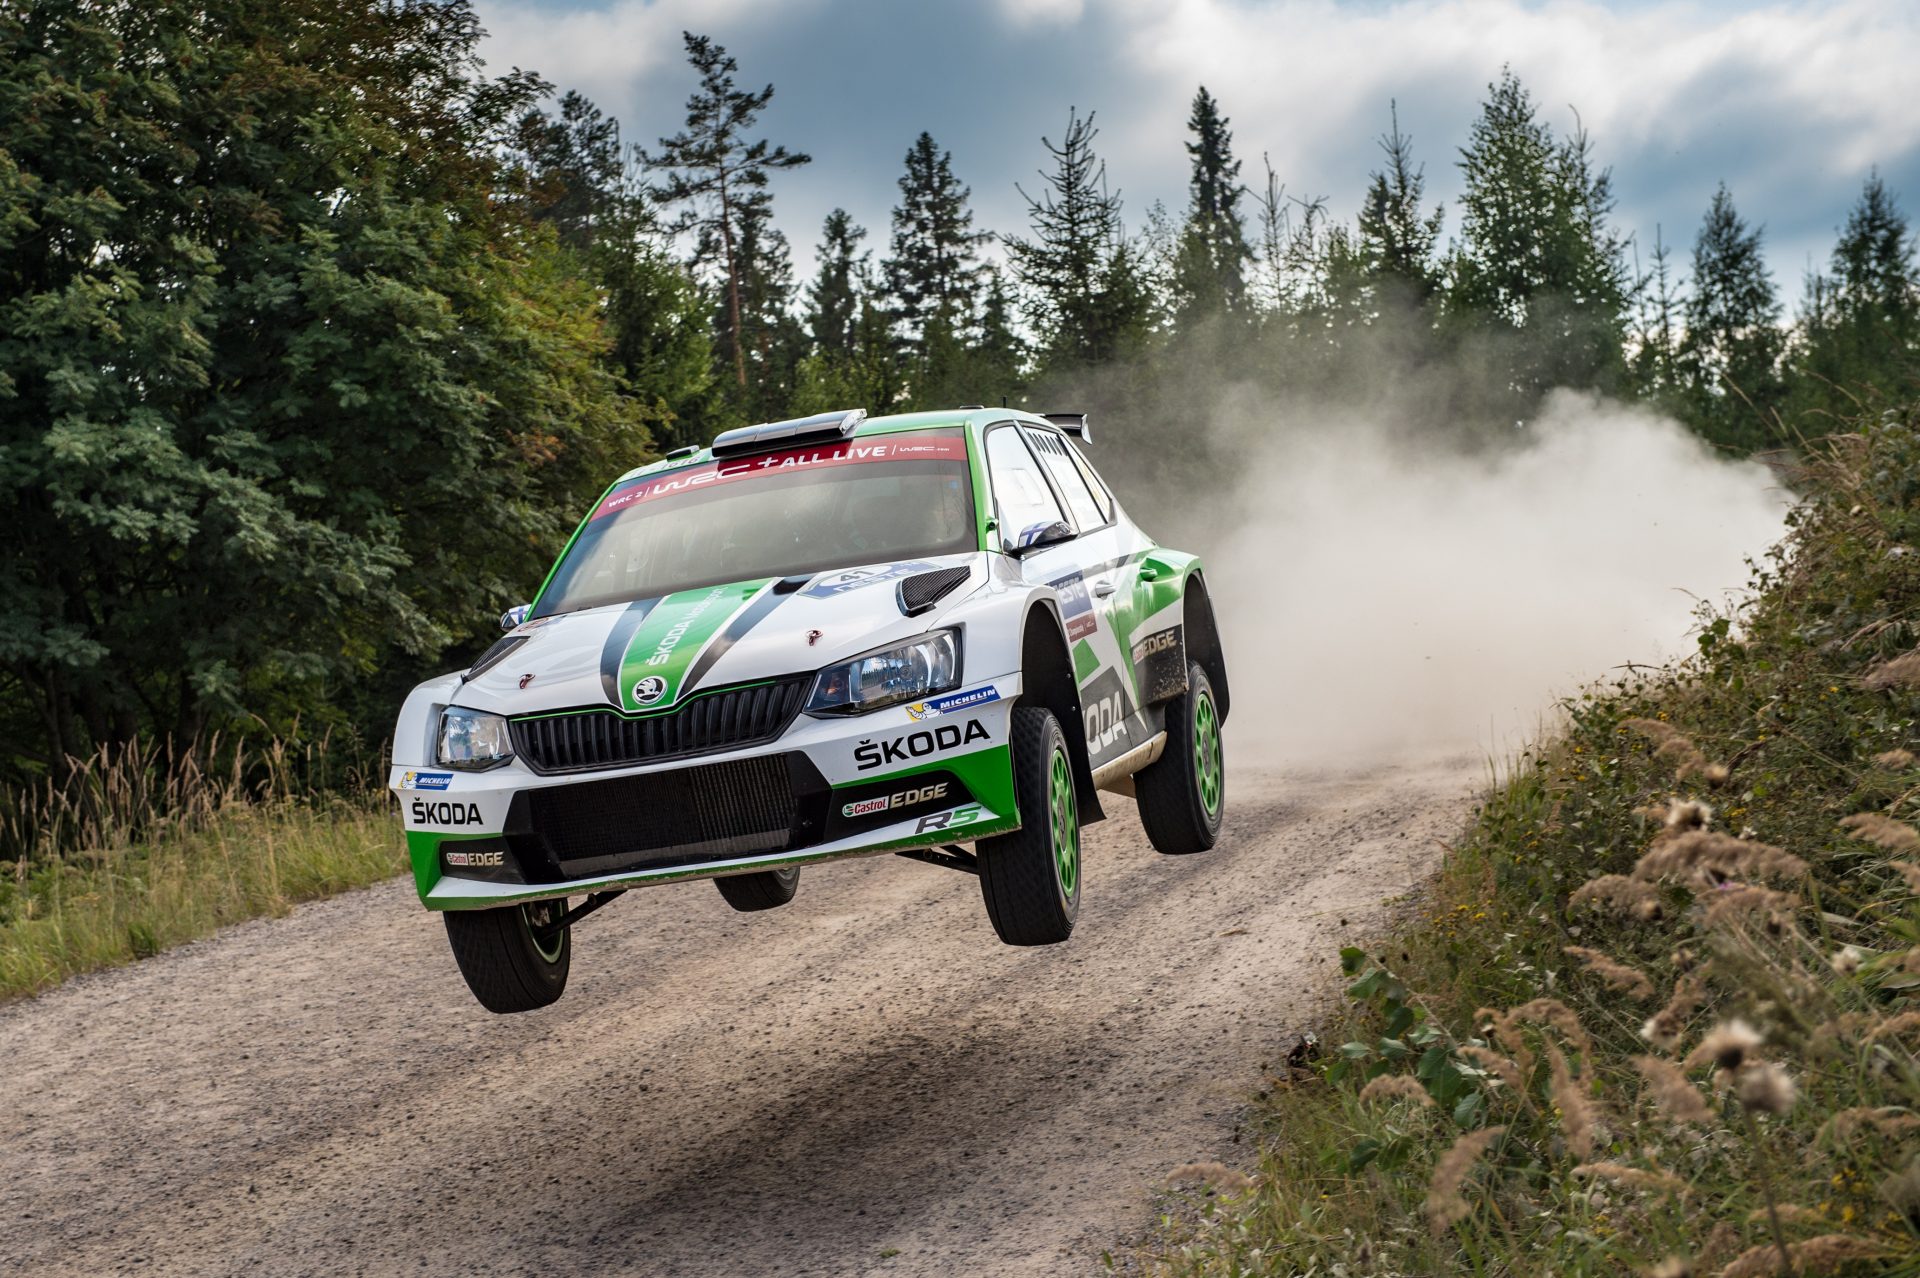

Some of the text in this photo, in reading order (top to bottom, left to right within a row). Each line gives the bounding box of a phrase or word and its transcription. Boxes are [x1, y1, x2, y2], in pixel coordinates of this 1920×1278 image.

[832, 445, 887, 462] LIVE
[840, 570, 875, 582] 41
[645, 619, 695, 666] ŠKODA
[1143, 629, 1177, 657] EDGE
[940, 688, 995, 708] MICHELIN
[1083, 690, 1127, 755] ODA
[853, 718, 991, 771] ŠKODA
[418, 777, 451, 785] MICHELIN
[412, 797, 484, 825] ŠKODA
[854, 782, 949, 814] Castrol EDGE
[914, 806, 982, 835] R5
[468, 851, 504, 866] EDGE
